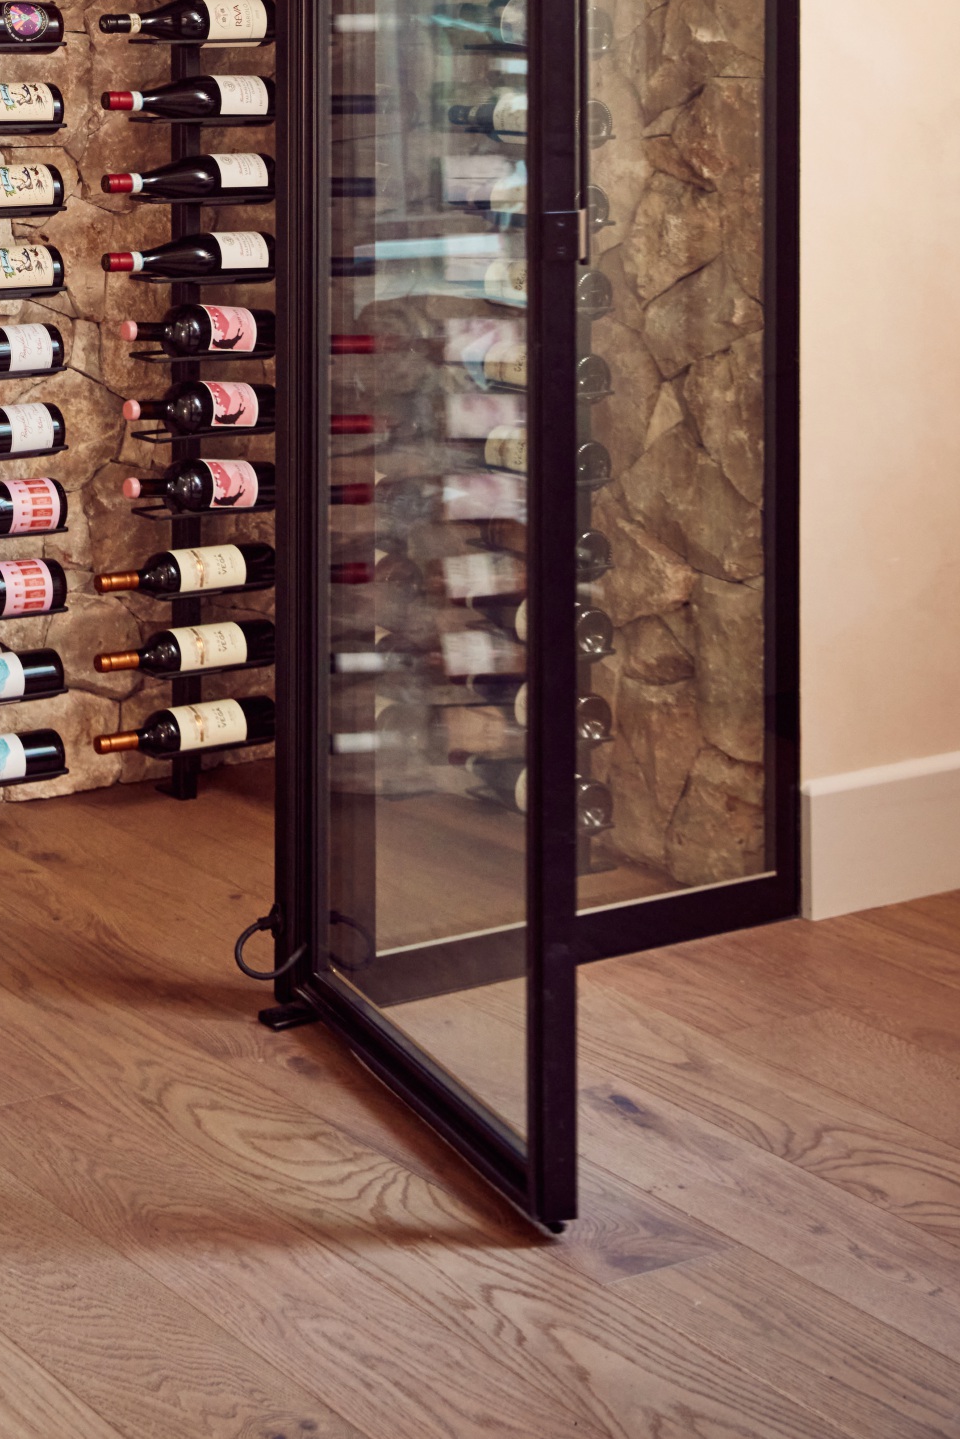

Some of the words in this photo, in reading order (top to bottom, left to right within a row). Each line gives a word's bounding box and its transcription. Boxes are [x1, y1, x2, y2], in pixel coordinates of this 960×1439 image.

[232, 4, 242, 27] RÉVA
[242, 3, 252, 28] BAROLO
[217, 554, 227, 575] VEGA
[217, 630, 227, 652] VEGA
[216, 707, 226, 728] VEGA
